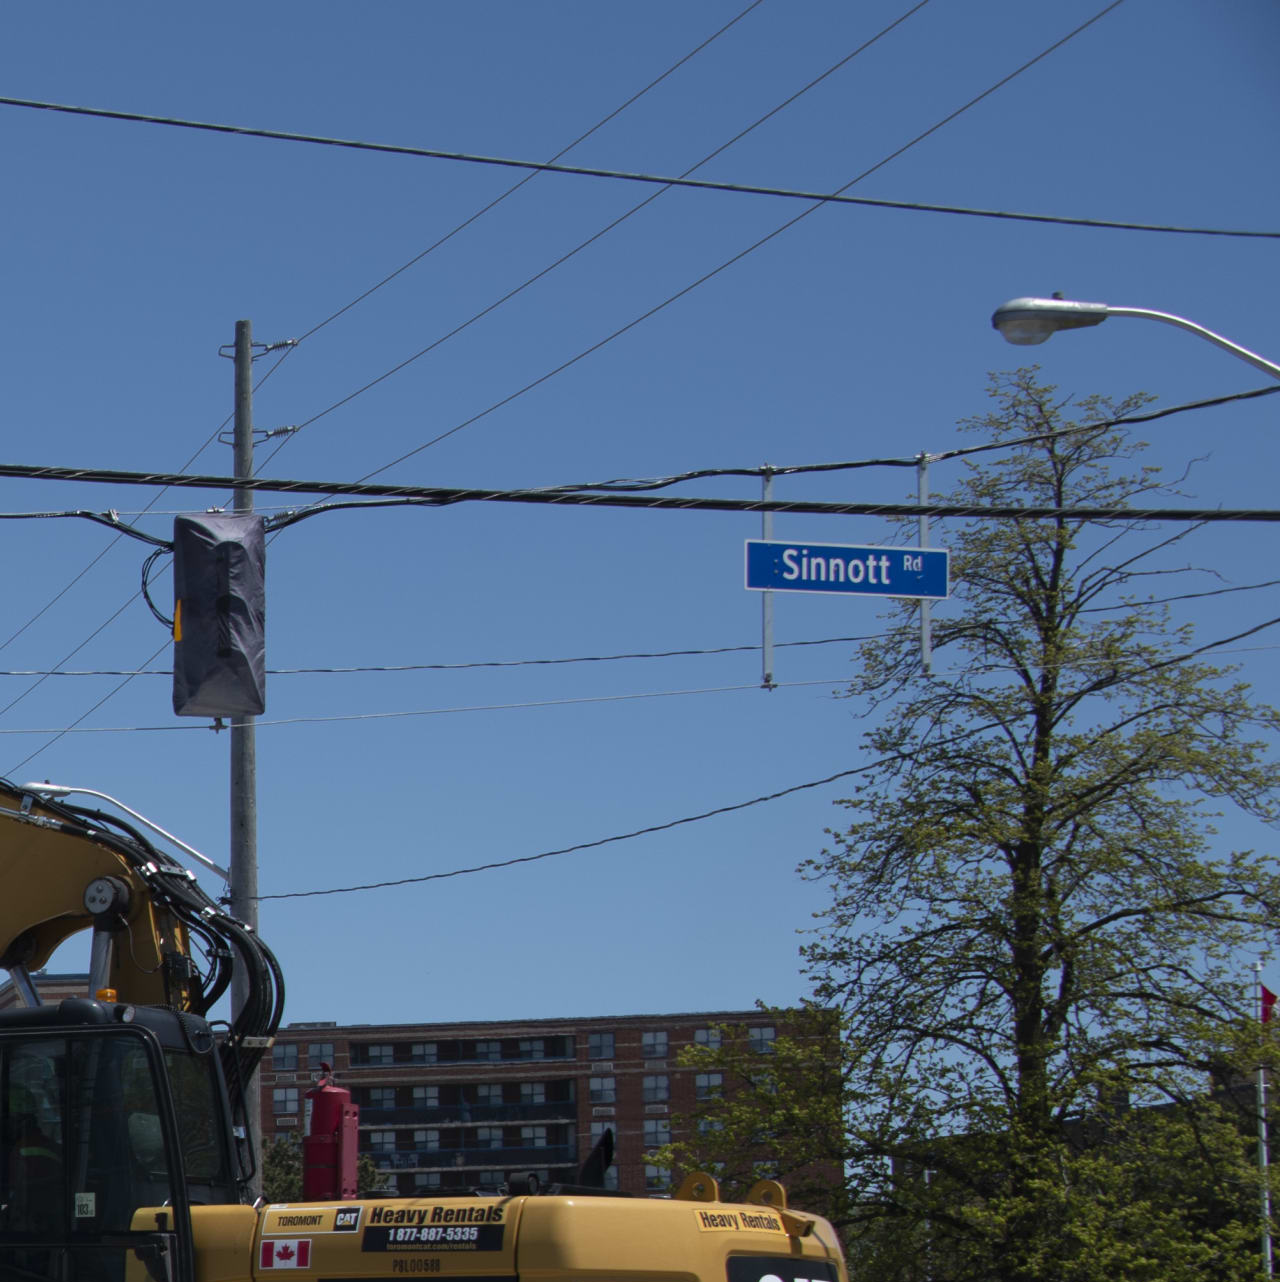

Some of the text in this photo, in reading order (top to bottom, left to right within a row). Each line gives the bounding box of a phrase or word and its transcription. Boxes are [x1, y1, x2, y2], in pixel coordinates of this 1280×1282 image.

[782, 548, 922, 584] Sinnott Rd
[277, 1215, 324, 1227] TOROMONT
[336, 1213, 358, 1226] CAT
[369, 1205, 504, 1224] Heavy Rentals
[699, 1211, 781, 1231] Heavy Rentals
[395, 1227, 478, 1241] 877-887-5335
